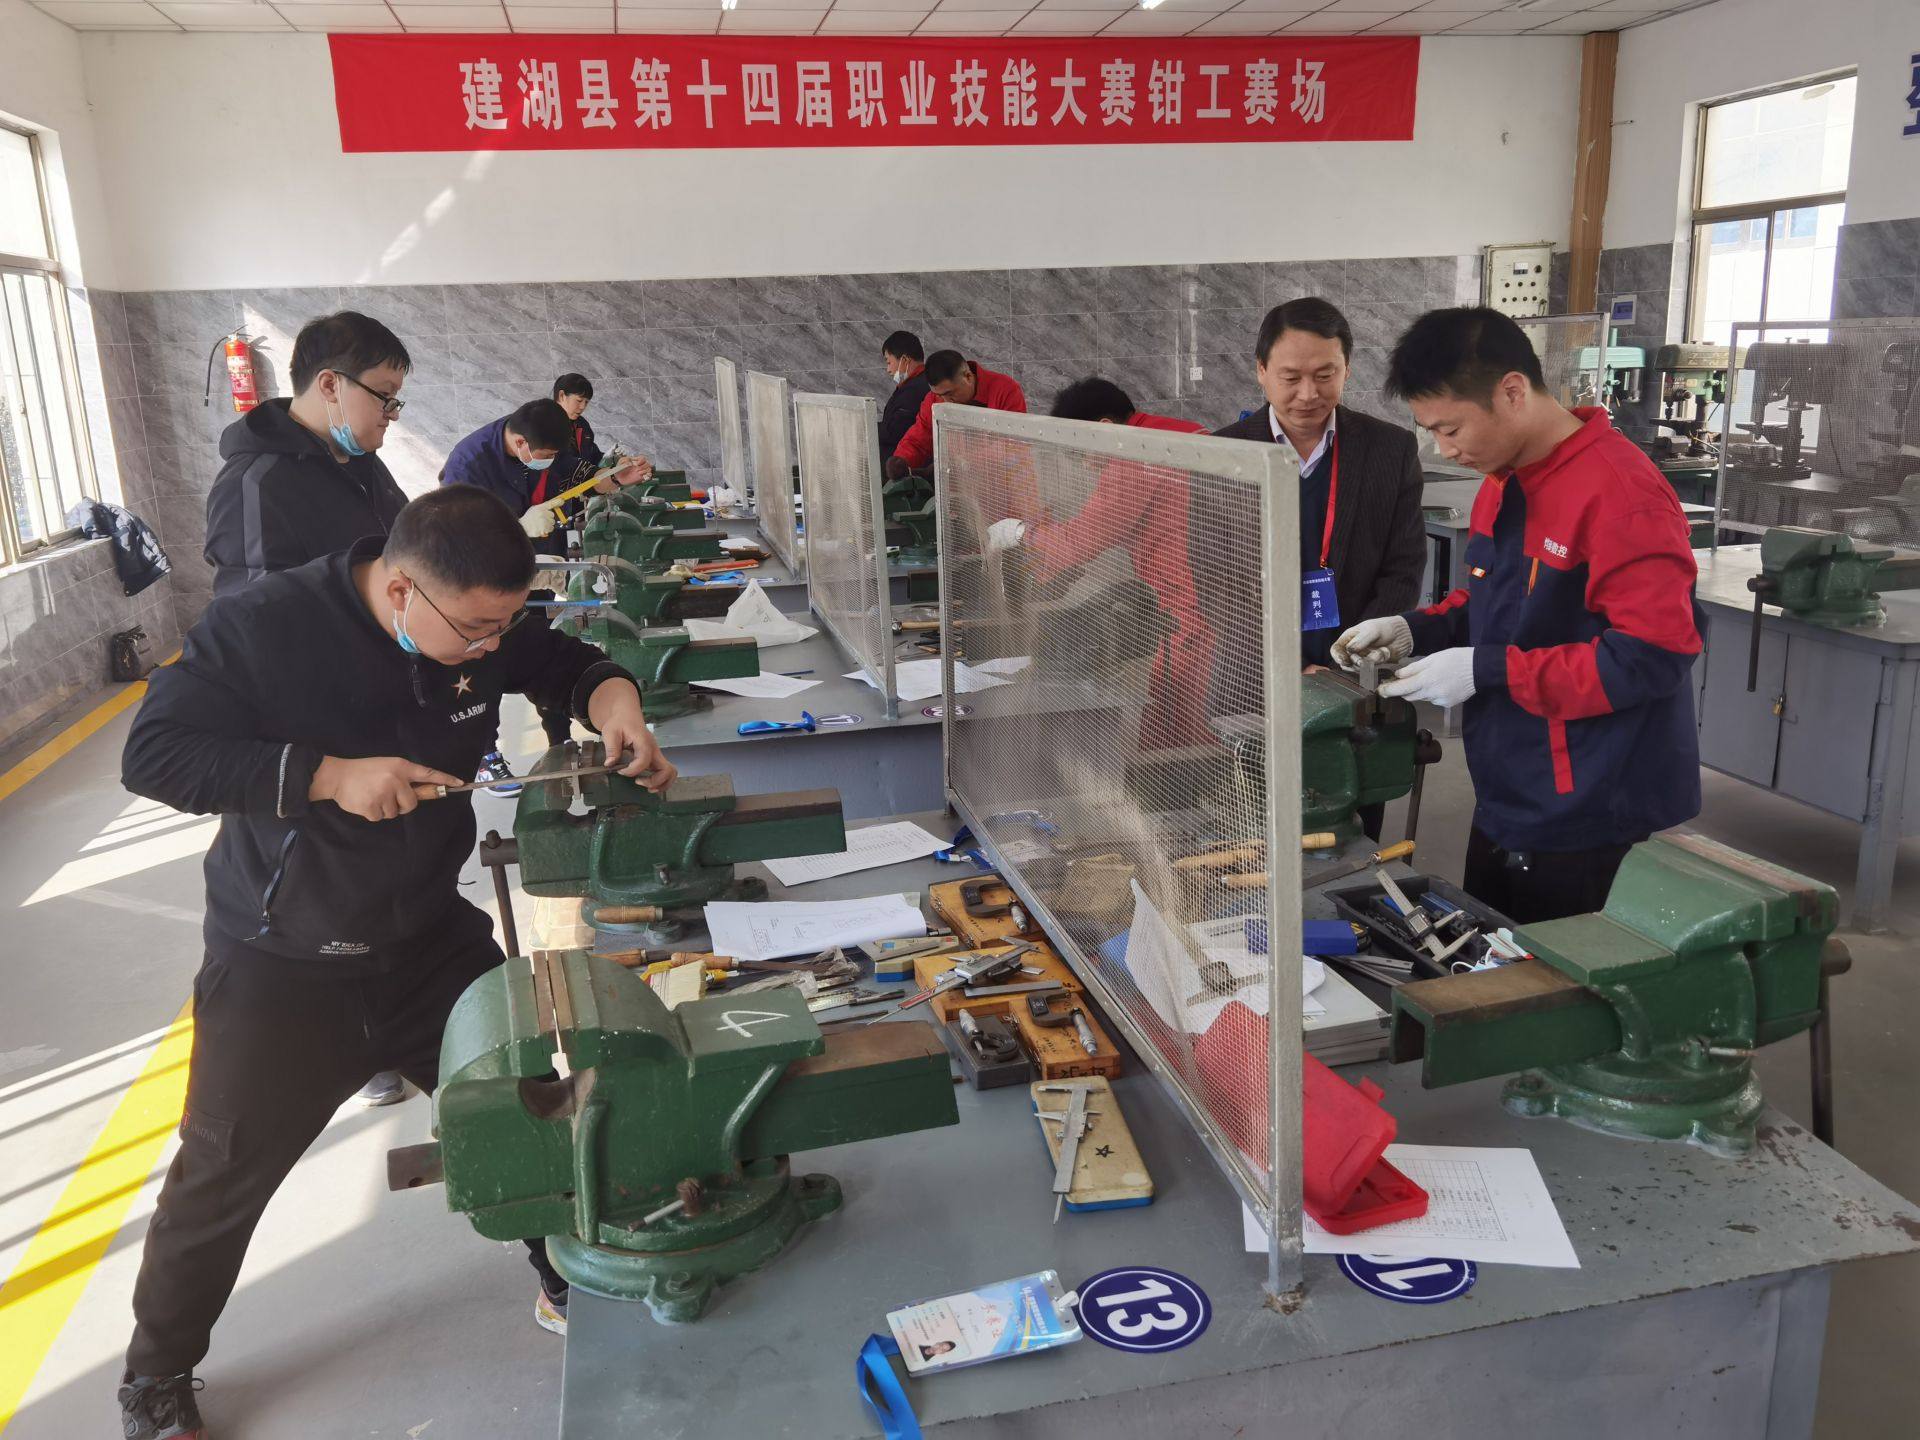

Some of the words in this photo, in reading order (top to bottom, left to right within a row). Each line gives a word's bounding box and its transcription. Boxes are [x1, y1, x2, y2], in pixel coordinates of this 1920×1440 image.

[459, 57, 1326, 131] 建湖县第十四届职业技能大赛钳工赛场
[1311, 590, 1323, 619] 裁判长
[450, 702, 487, 723] U.S.ARMY
[820, 714, 854, 725] 17
[1096, 1278, 1188, 1338] 13
